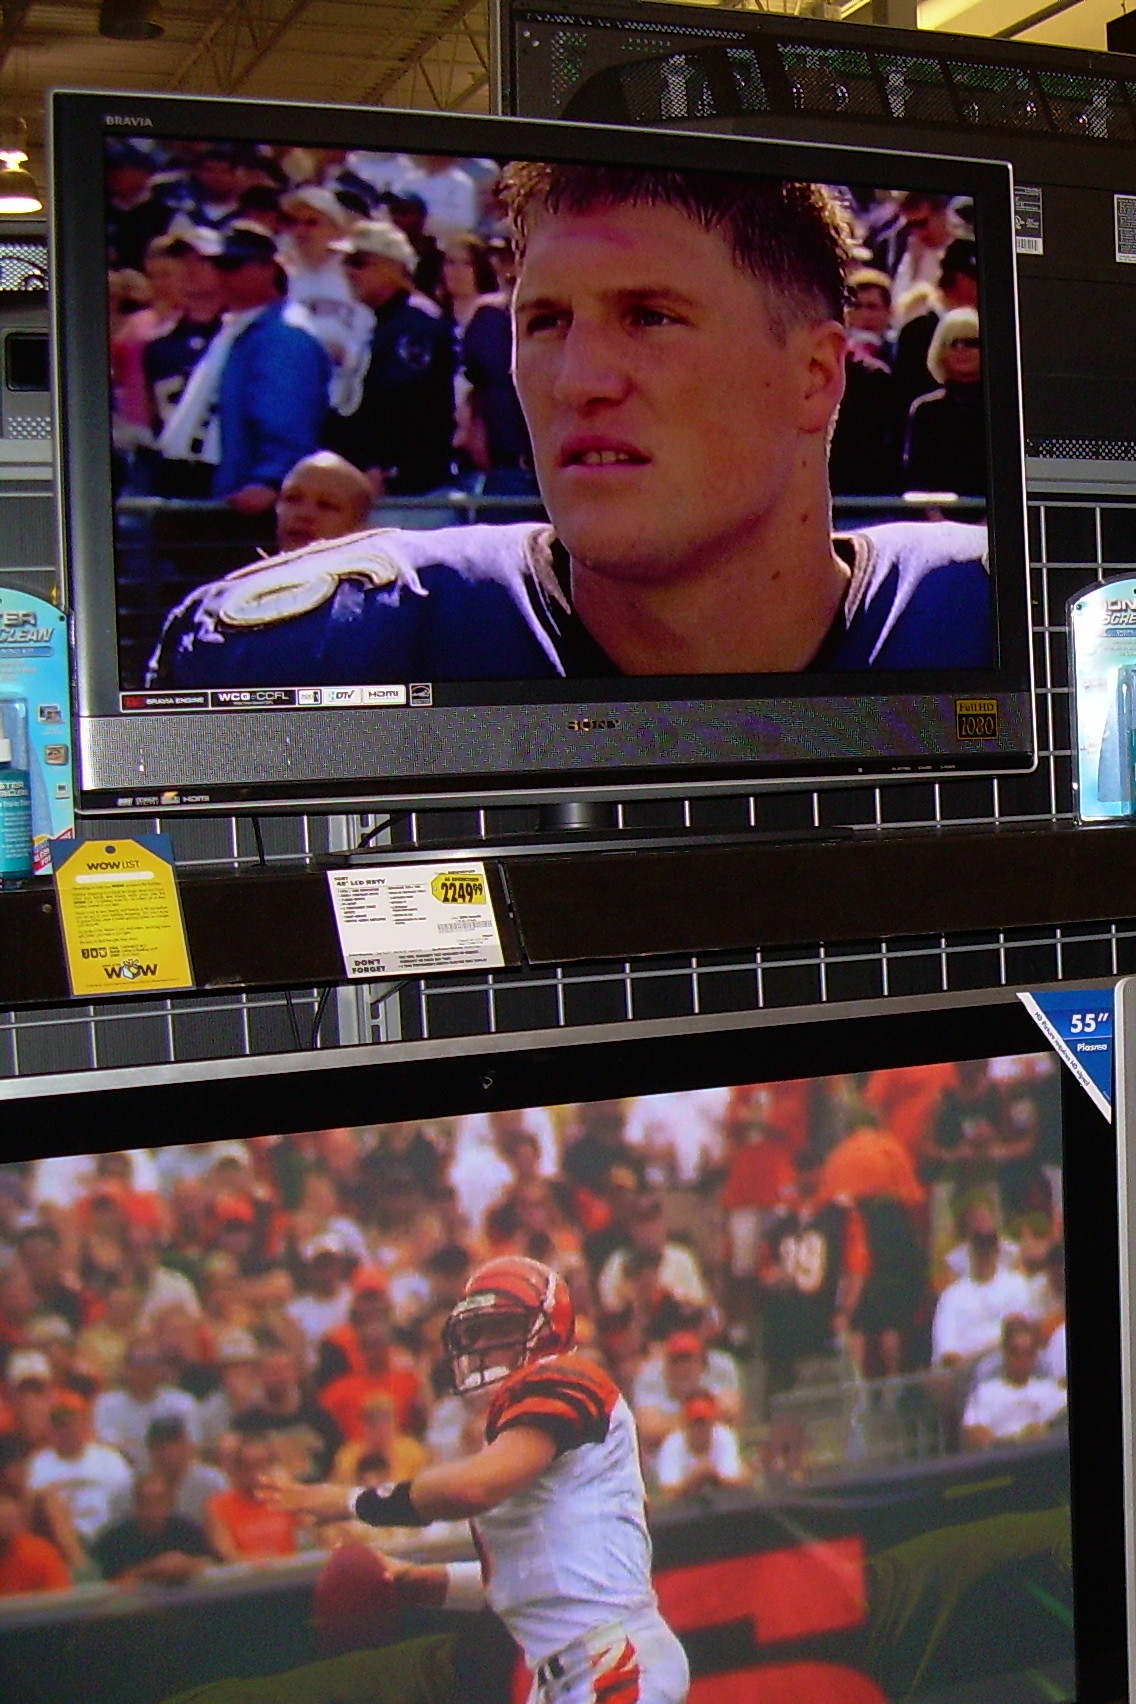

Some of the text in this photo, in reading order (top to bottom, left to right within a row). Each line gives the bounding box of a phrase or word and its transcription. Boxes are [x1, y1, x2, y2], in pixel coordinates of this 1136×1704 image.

[105, 115, 154, 127] BRAVIA
[368, 690, 399, 699] HDMI
[565, 718, 621, 732] SONY
[961, 716, 994, 735] 1080
[87, 860, 140, 871] WOW LIST
[1070, 1012, 1109, 1034] 55"
[1076, 1042, 1108, 1052] Plasma
